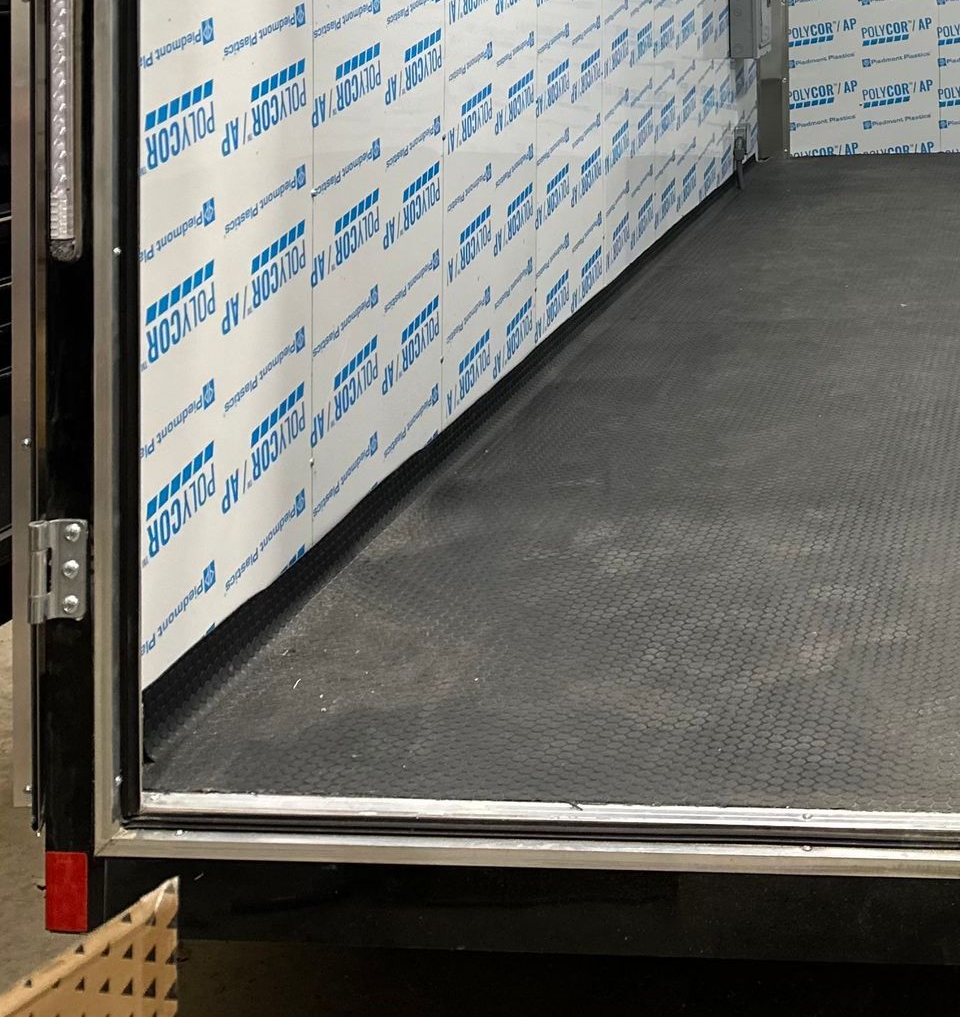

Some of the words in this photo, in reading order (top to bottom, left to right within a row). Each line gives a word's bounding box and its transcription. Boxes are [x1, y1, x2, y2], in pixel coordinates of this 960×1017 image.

[258, 12, 294, 43] Piedmont
[386, 5, 408, 28] Plastics
[153, 28, 200, 65] Piedmont
[223, 30, 257, 60] Plastics
[341, 147, 371, 180] Piedmont
[313, 169, 340, 201] Plastics
[154, 210, 202, 256] Piedmont
[258, 339, 294, 385] Piedmont
[224, 373, 257, 416] Plastics
[155, 393, 201, 449] Piedmont
